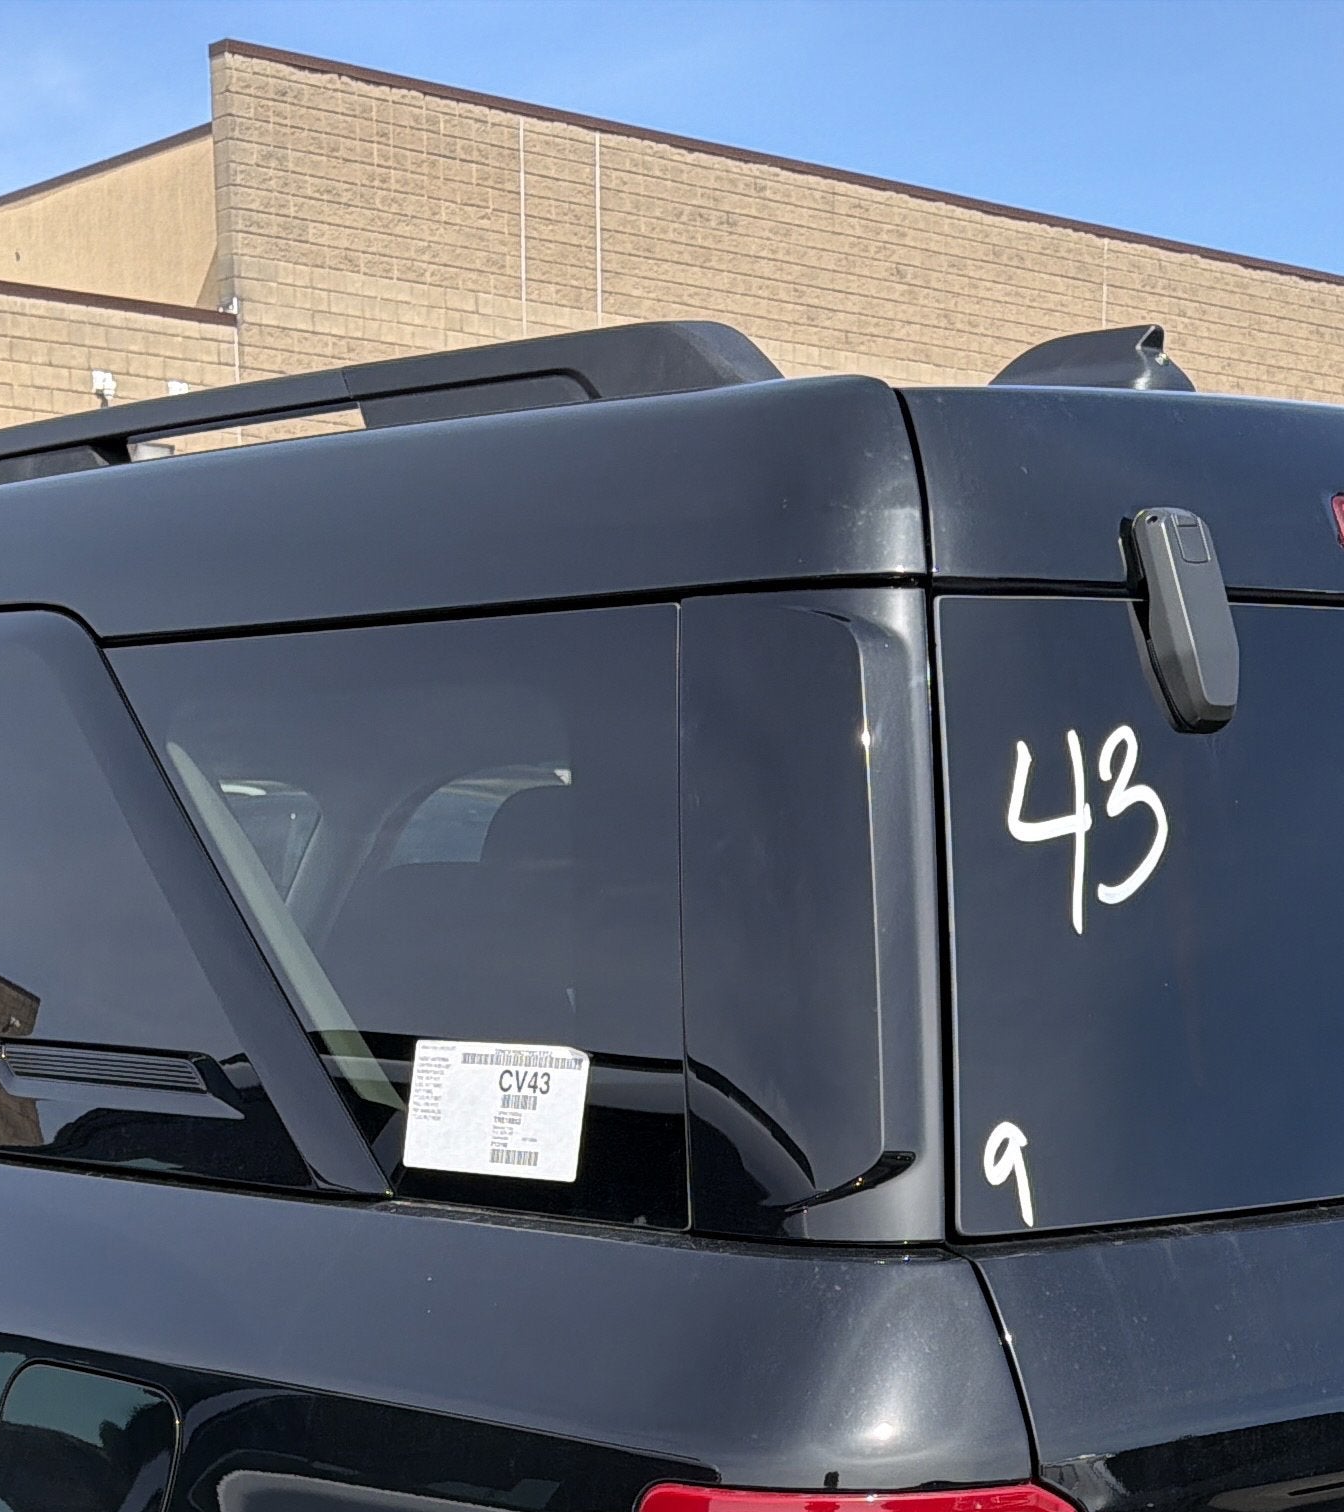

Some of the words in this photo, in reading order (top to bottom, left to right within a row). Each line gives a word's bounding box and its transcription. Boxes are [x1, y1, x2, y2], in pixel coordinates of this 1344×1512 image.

[1007, 725, 1169, 935] 43
[498, 1069, 551, 1095] CV43
[983, 1121, 1034, 1228] 9
